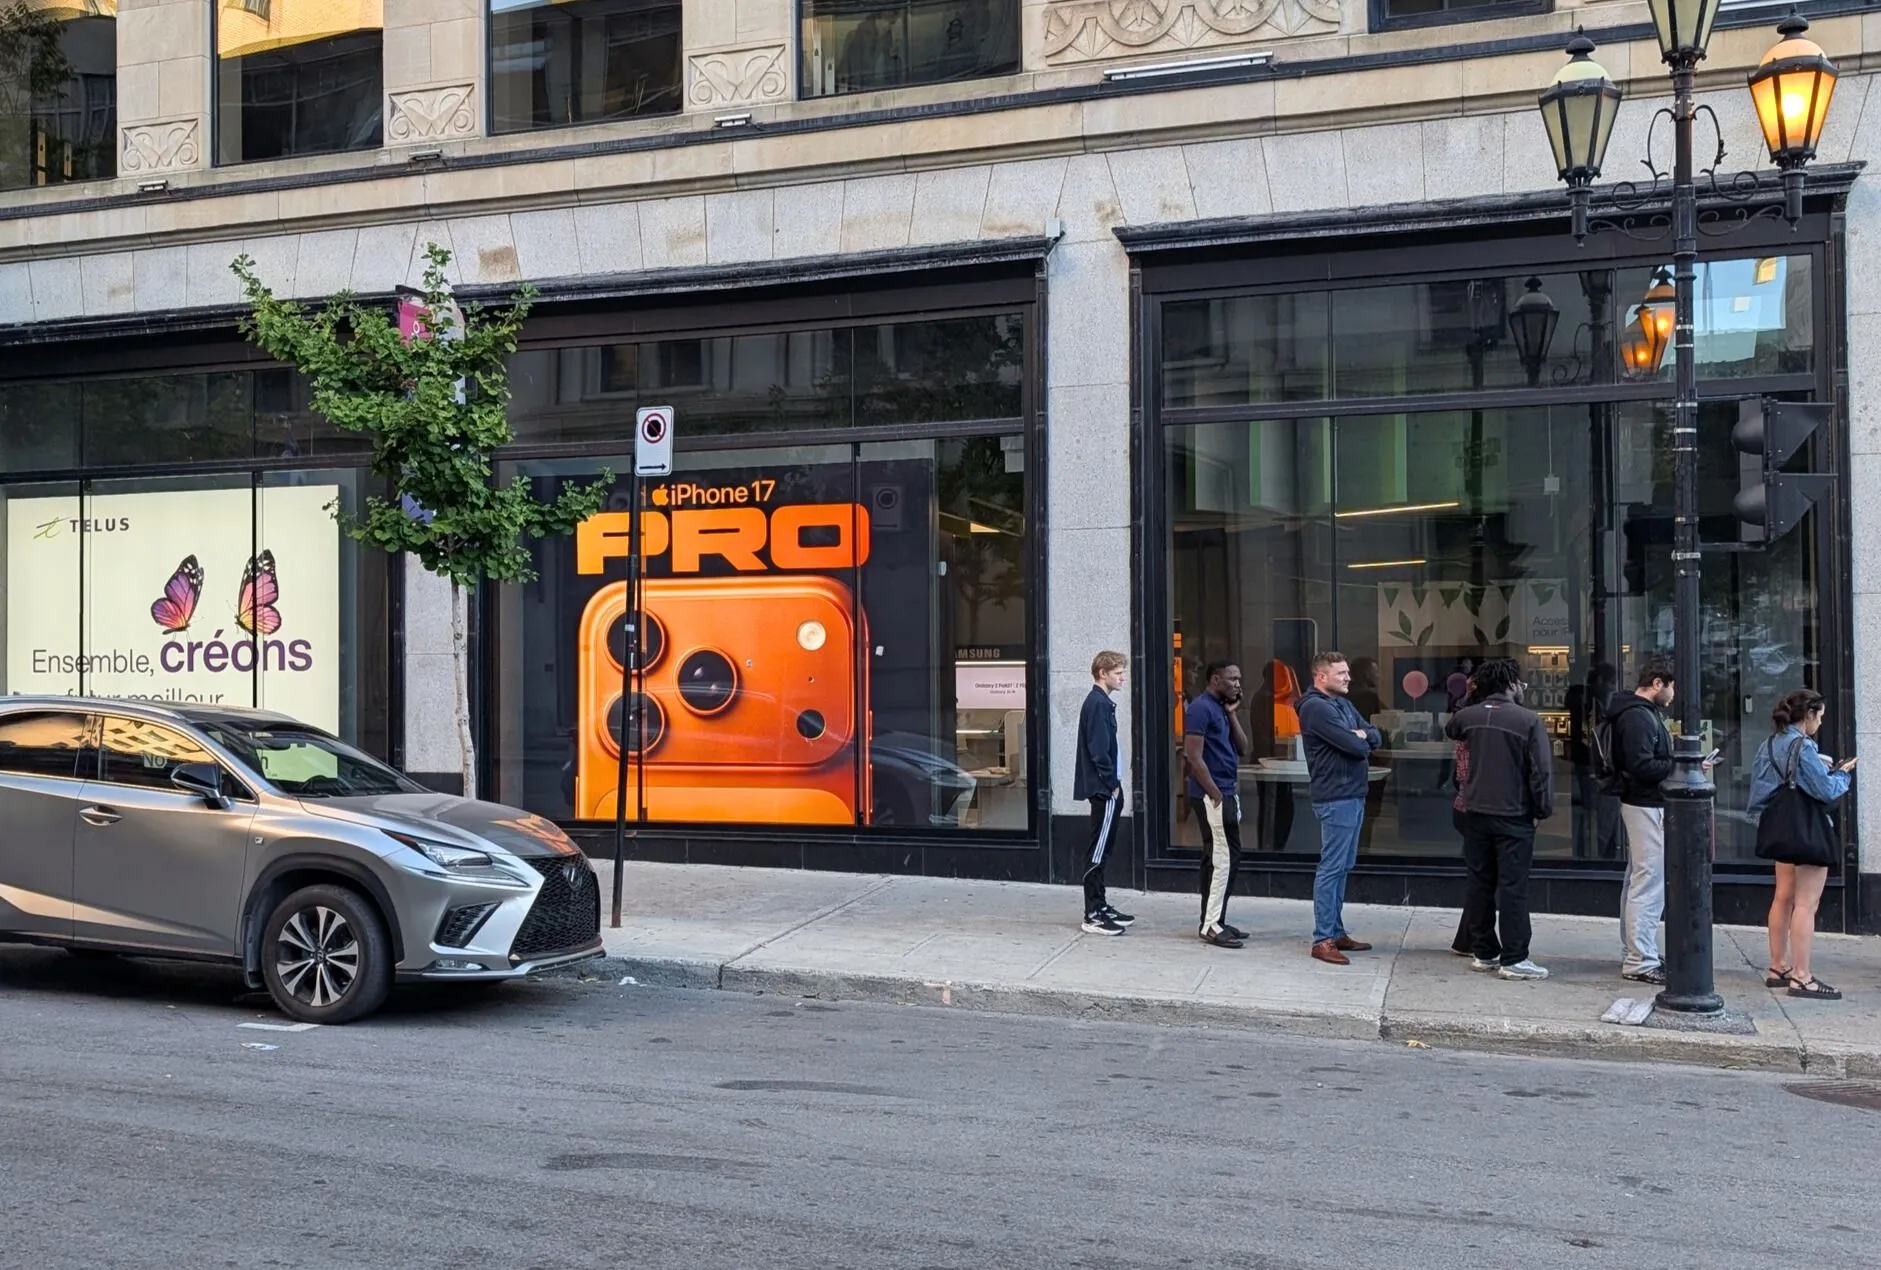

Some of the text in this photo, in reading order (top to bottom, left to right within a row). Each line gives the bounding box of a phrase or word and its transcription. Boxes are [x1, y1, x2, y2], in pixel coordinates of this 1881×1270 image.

[671, 480, 776, 505] iPhone 17
[69, 517, 130, 533] TELUS
[577, 503, 870, 575] PRO
[32, 629, 313, 678] Ensemble, créons
